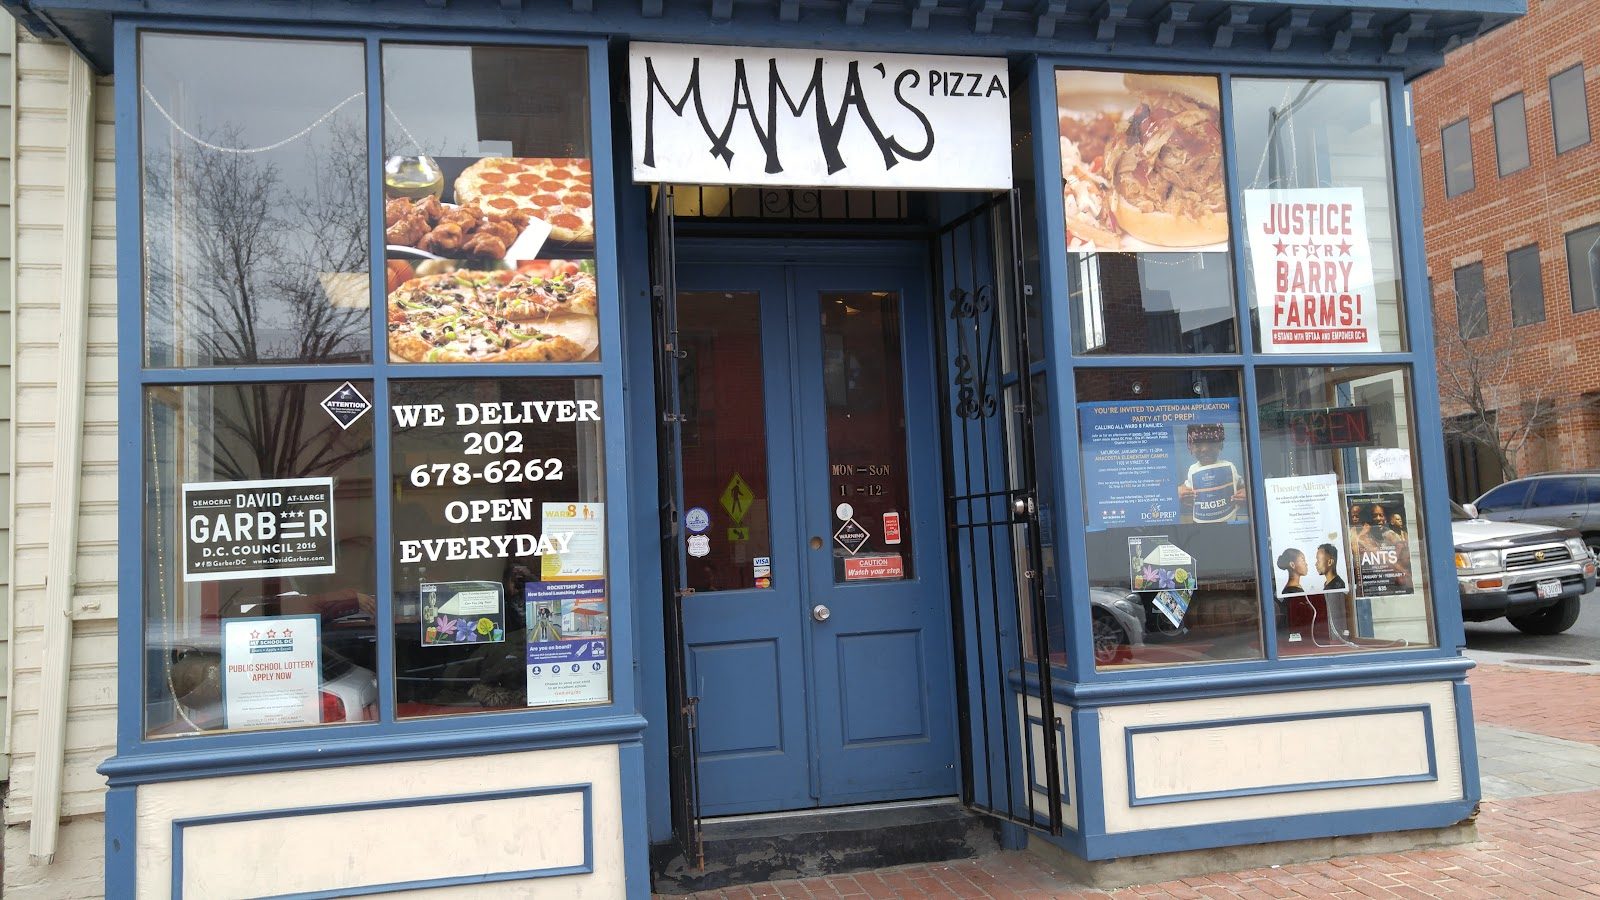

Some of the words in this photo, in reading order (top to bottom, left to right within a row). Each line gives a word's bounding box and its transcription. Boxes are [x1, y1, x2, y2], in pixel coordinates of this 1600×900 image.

[643, 57, 935, 176] MAMA'S
[929, 70, 1008, 99] PIZZA
[1263, 203, 1352, 236] JUSTICE
[1292, 243, 1334, 258] FOR
[1276, 260, 1354, 293] BARRY
[1273, 294, 1362, 327] FARMS!
[1278, 332, 1293, 341] STAND
[1322, 332, 1331, 341] AND
[1332, 331, 1354, 340] EMPOWER
[327, 401, 366, 409] ATTENTION
[1094, 406, 1119, 415] YOU'RE
[1119, 405, 1145, 414] INVITED
[1146, 405, 1154, 413] TO
[1155, 404, 1180, 413] ATTEND
[1180, 404, 1190, 412] AN
[1191, 401, 1230, 412] APPLICATION
[392, 404, 445, 428] WE
[456, 399, 601, 426] DELIVER
[1132, 415, 1152, 424] PARTY
[1152, 415, 1160, 423] AT
[1162, 413, 1173, 422] DC
[1174, 412, 1195, 422] PREP!
[1291, 411, 1366, 446] OPEN
[463, 430, 524, 455] 202
[410, 458, 564, 488] 678-6262
[1272, 483, 1300, 495] Theater
[1302, 481, 1331, 492] Alliance
[193, 498, 232, 507] DEMOCRAT
[236, 492, 282, 509] DAVID
[287, 493, 325, 502] AT-LARGE
[1200, 498, 1227, 510] EAGER
[444, 497, 534, 524] OPEN
[1159, 511, 1177, 519] PREP
[839, 532, 865, 540] WARNING
[203, 547, 229, 558] D.C.
[232, 543, 294, 556] COUNCIL
[297, 542, 317, 550] 2016
[399, 531, 575, 563] EVERYDAY
[213, 559, 247, 567] GarberDC
[253, 556, 325, 565] www.DavidGarber.com
[859, 558, 888, 567] CAUTION
[1361, 550, 1398, 566] ANTS
[848, 568, 869, 578] Watch
[870, 568, 886, 578] your
[553, 589, 575, 597] Launching
[576, 588, 592, 596] August
[228, 663, 254, 673] PUBLIC
[255, 661, 282, 672] SCHOOL
[284, 659, 315, 671] LOTTERY
[252, 672, 274, 682] APPLY
[275, 671, 293, 681] NOW
